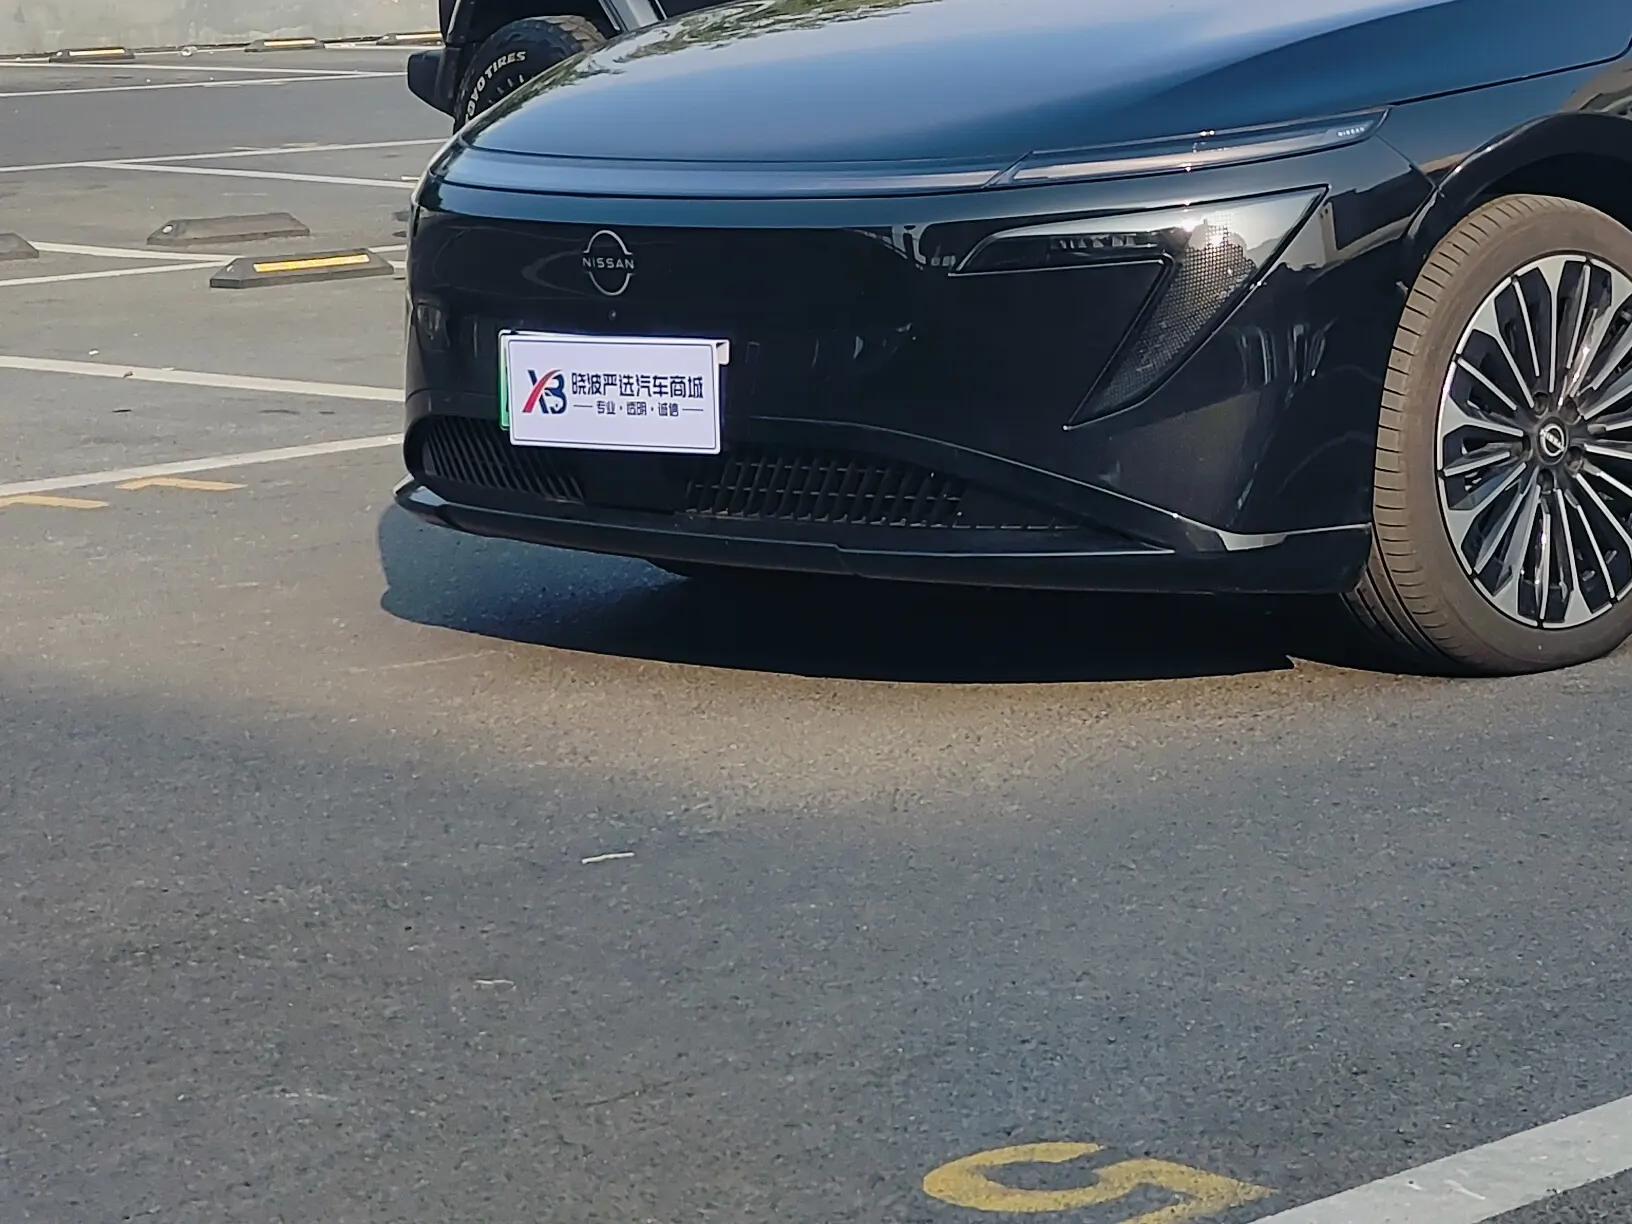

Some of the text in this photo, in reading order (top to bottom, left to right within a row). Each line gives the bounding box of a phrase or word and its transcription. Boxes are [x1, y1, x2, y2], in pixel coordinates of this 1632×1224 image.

[485, 51, 526, 79] TIRES
[582, 257, 634, 269] NISSAN
[571, 372, 704, 399] 晓波严选汽车商城
